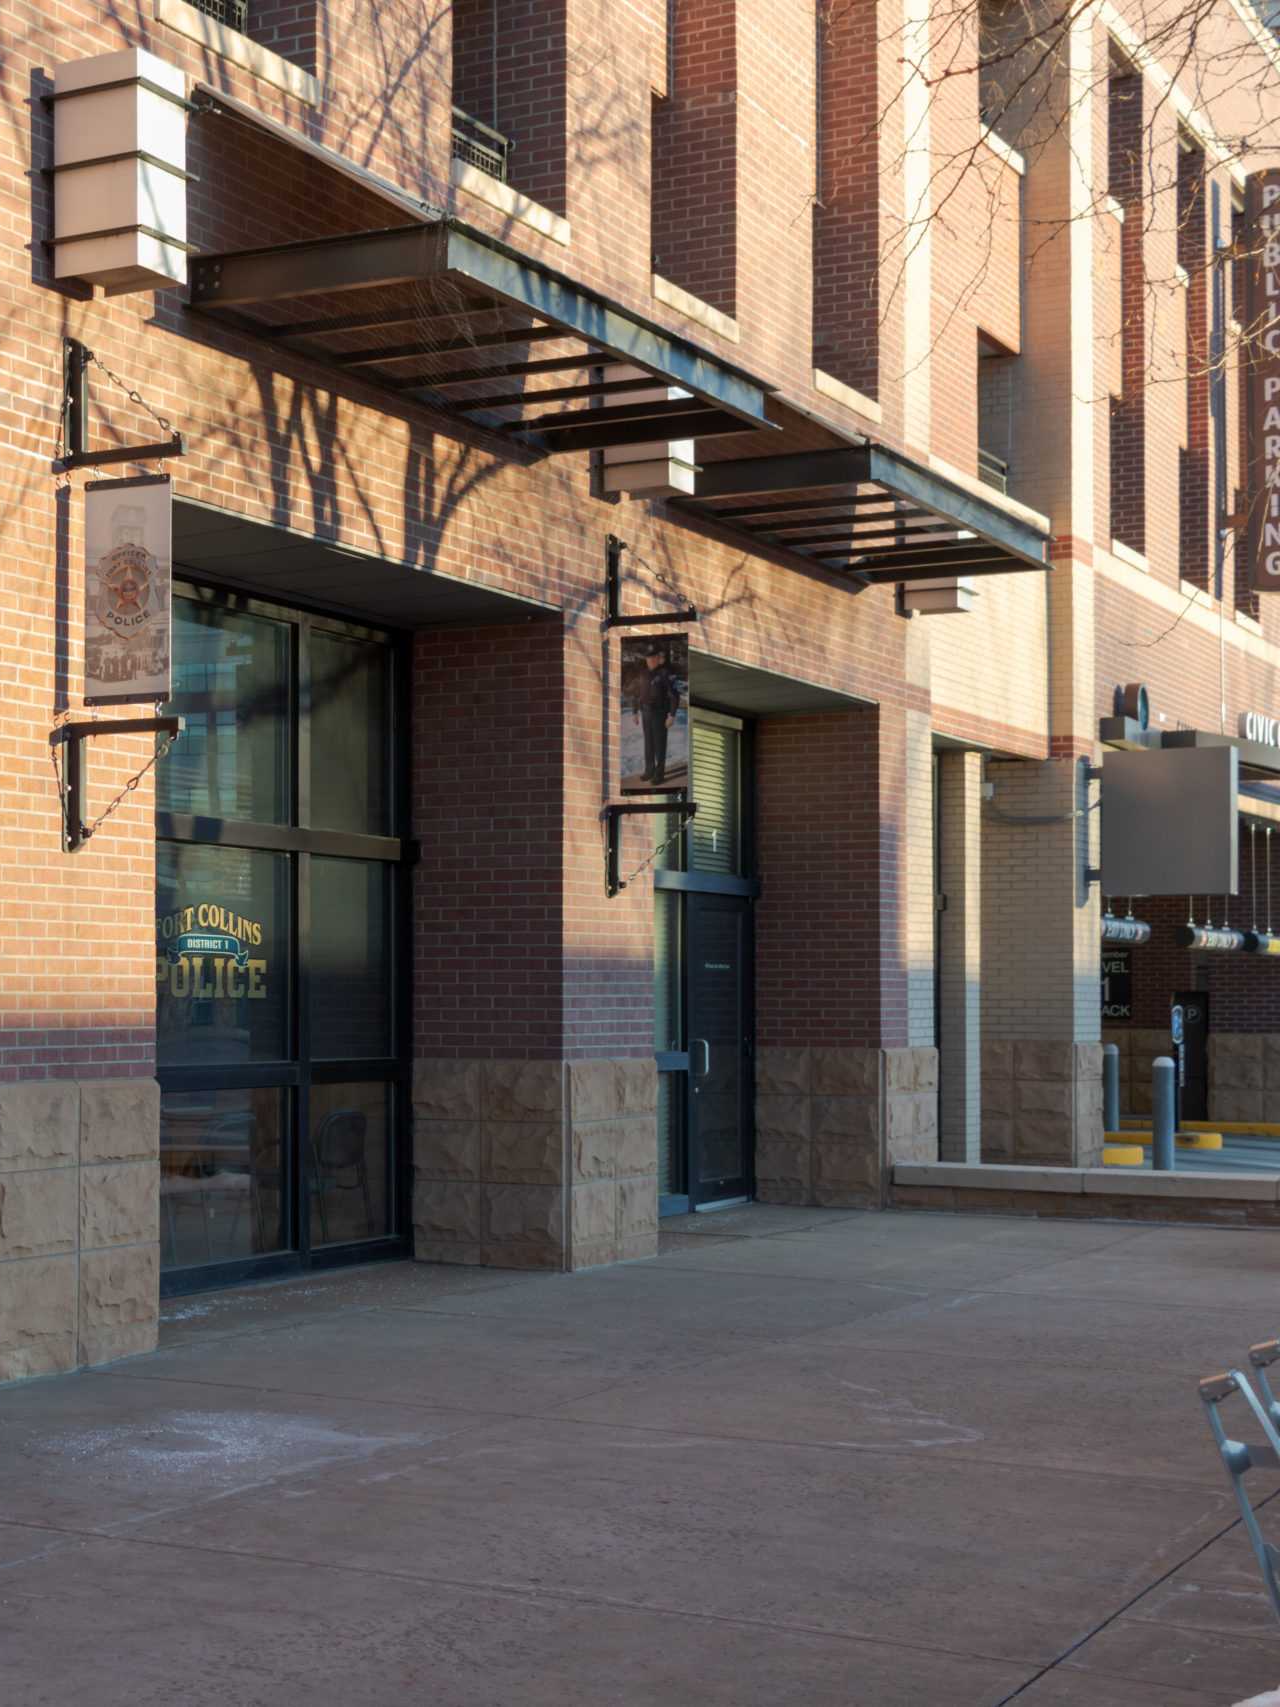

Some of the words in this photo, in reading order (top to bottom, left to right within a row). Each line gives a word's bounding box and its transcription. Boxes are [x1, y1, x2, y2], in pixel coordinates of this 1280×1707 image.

[1261, 184, 1280, 354] PUBLIC
[1263, 376, 1280, 576] PARKING
[106, 610, 152, 627] POLICE
[1246, 711, 1276, 748] CIVIC
[198, 904, 262, 945] COLLINS
[187, 938, 222, 950] DISTRICT
[1102, 961, 1129, 973] VEL
[1102, 1004, 1131, 1017] ACK
